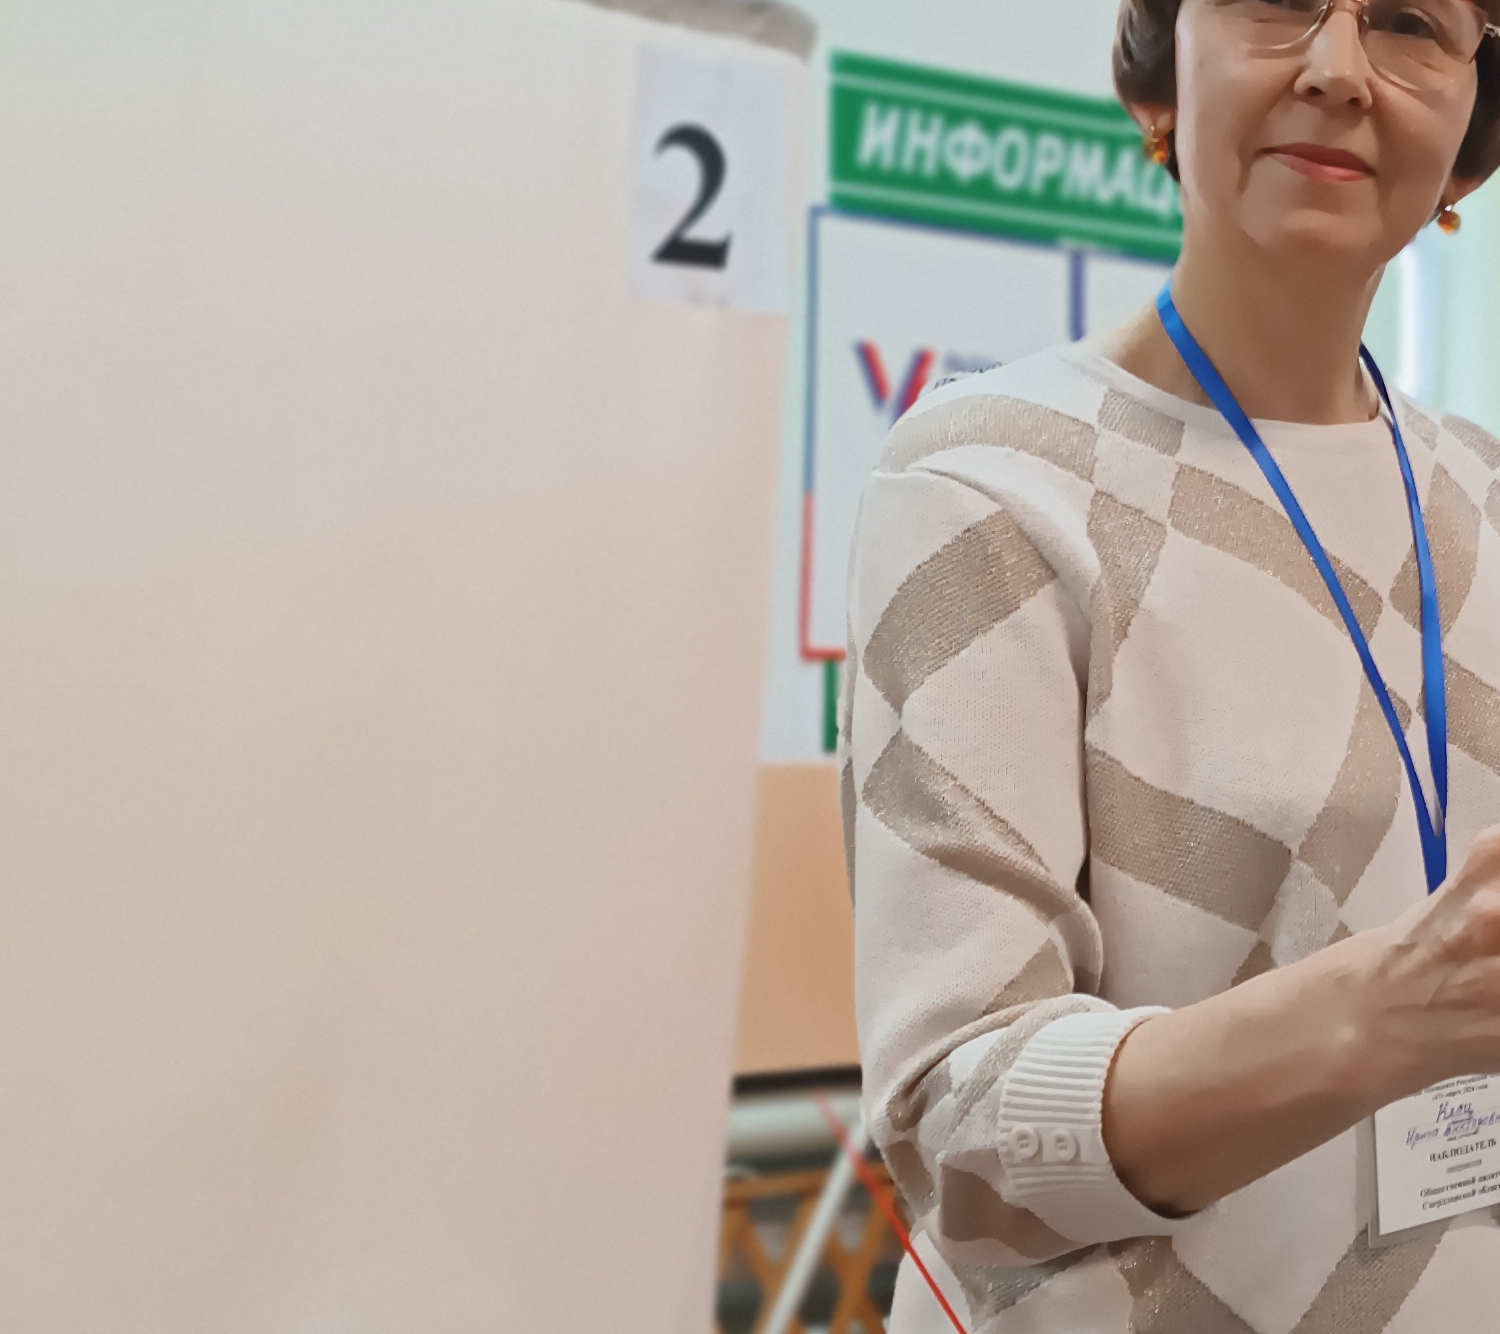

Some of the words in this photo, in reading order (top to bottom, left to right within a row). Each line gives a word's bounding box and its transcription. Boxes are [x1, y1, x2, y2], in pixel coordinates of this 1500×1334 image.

[651, 122, 732, 272] 2
[857, 100, 1184, 221] ИНФОРМАЦ
[1429, 1137, 1497, 1163] НАБЛЮДАТЕЛЬ
